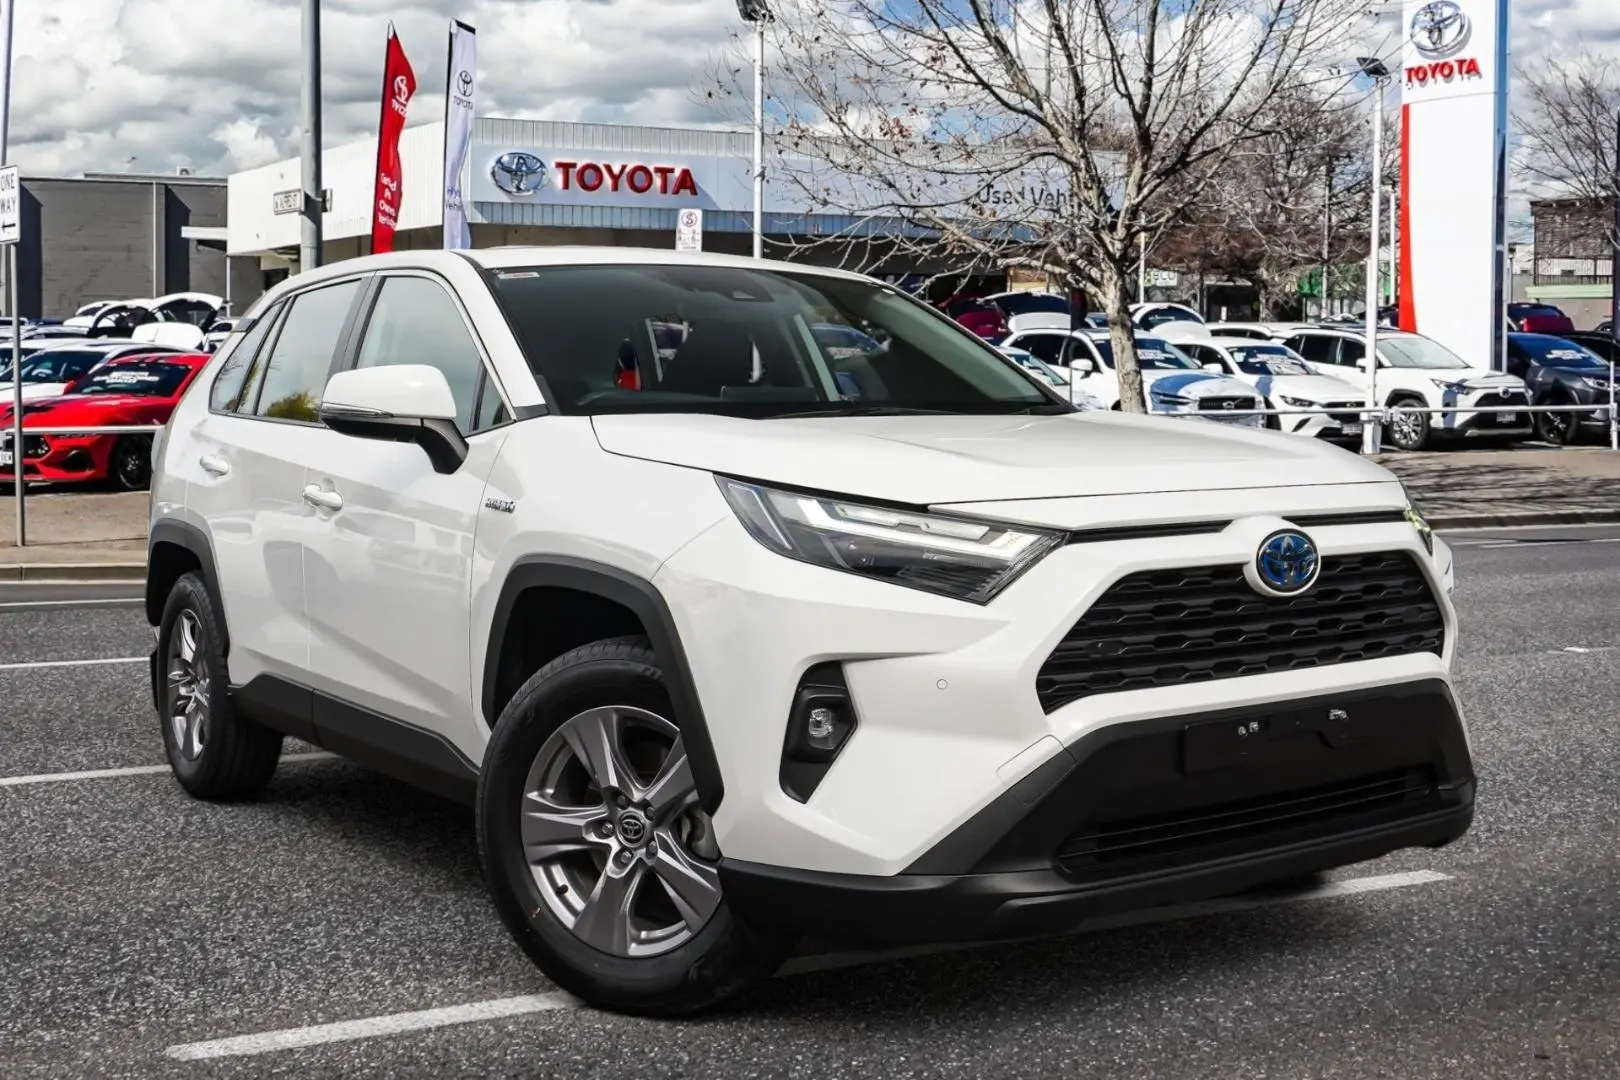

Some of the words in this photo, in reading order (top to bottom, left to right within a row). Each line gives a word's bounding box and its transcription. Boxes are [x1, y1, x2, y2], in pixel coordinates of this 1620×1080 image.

[1404, 58, 1480, 83] TOYOTA
[0, 173, 15, 191] ONE
[554, 160, 698, 196] TOYOTA
[0, 196, 17, 214] WAY
